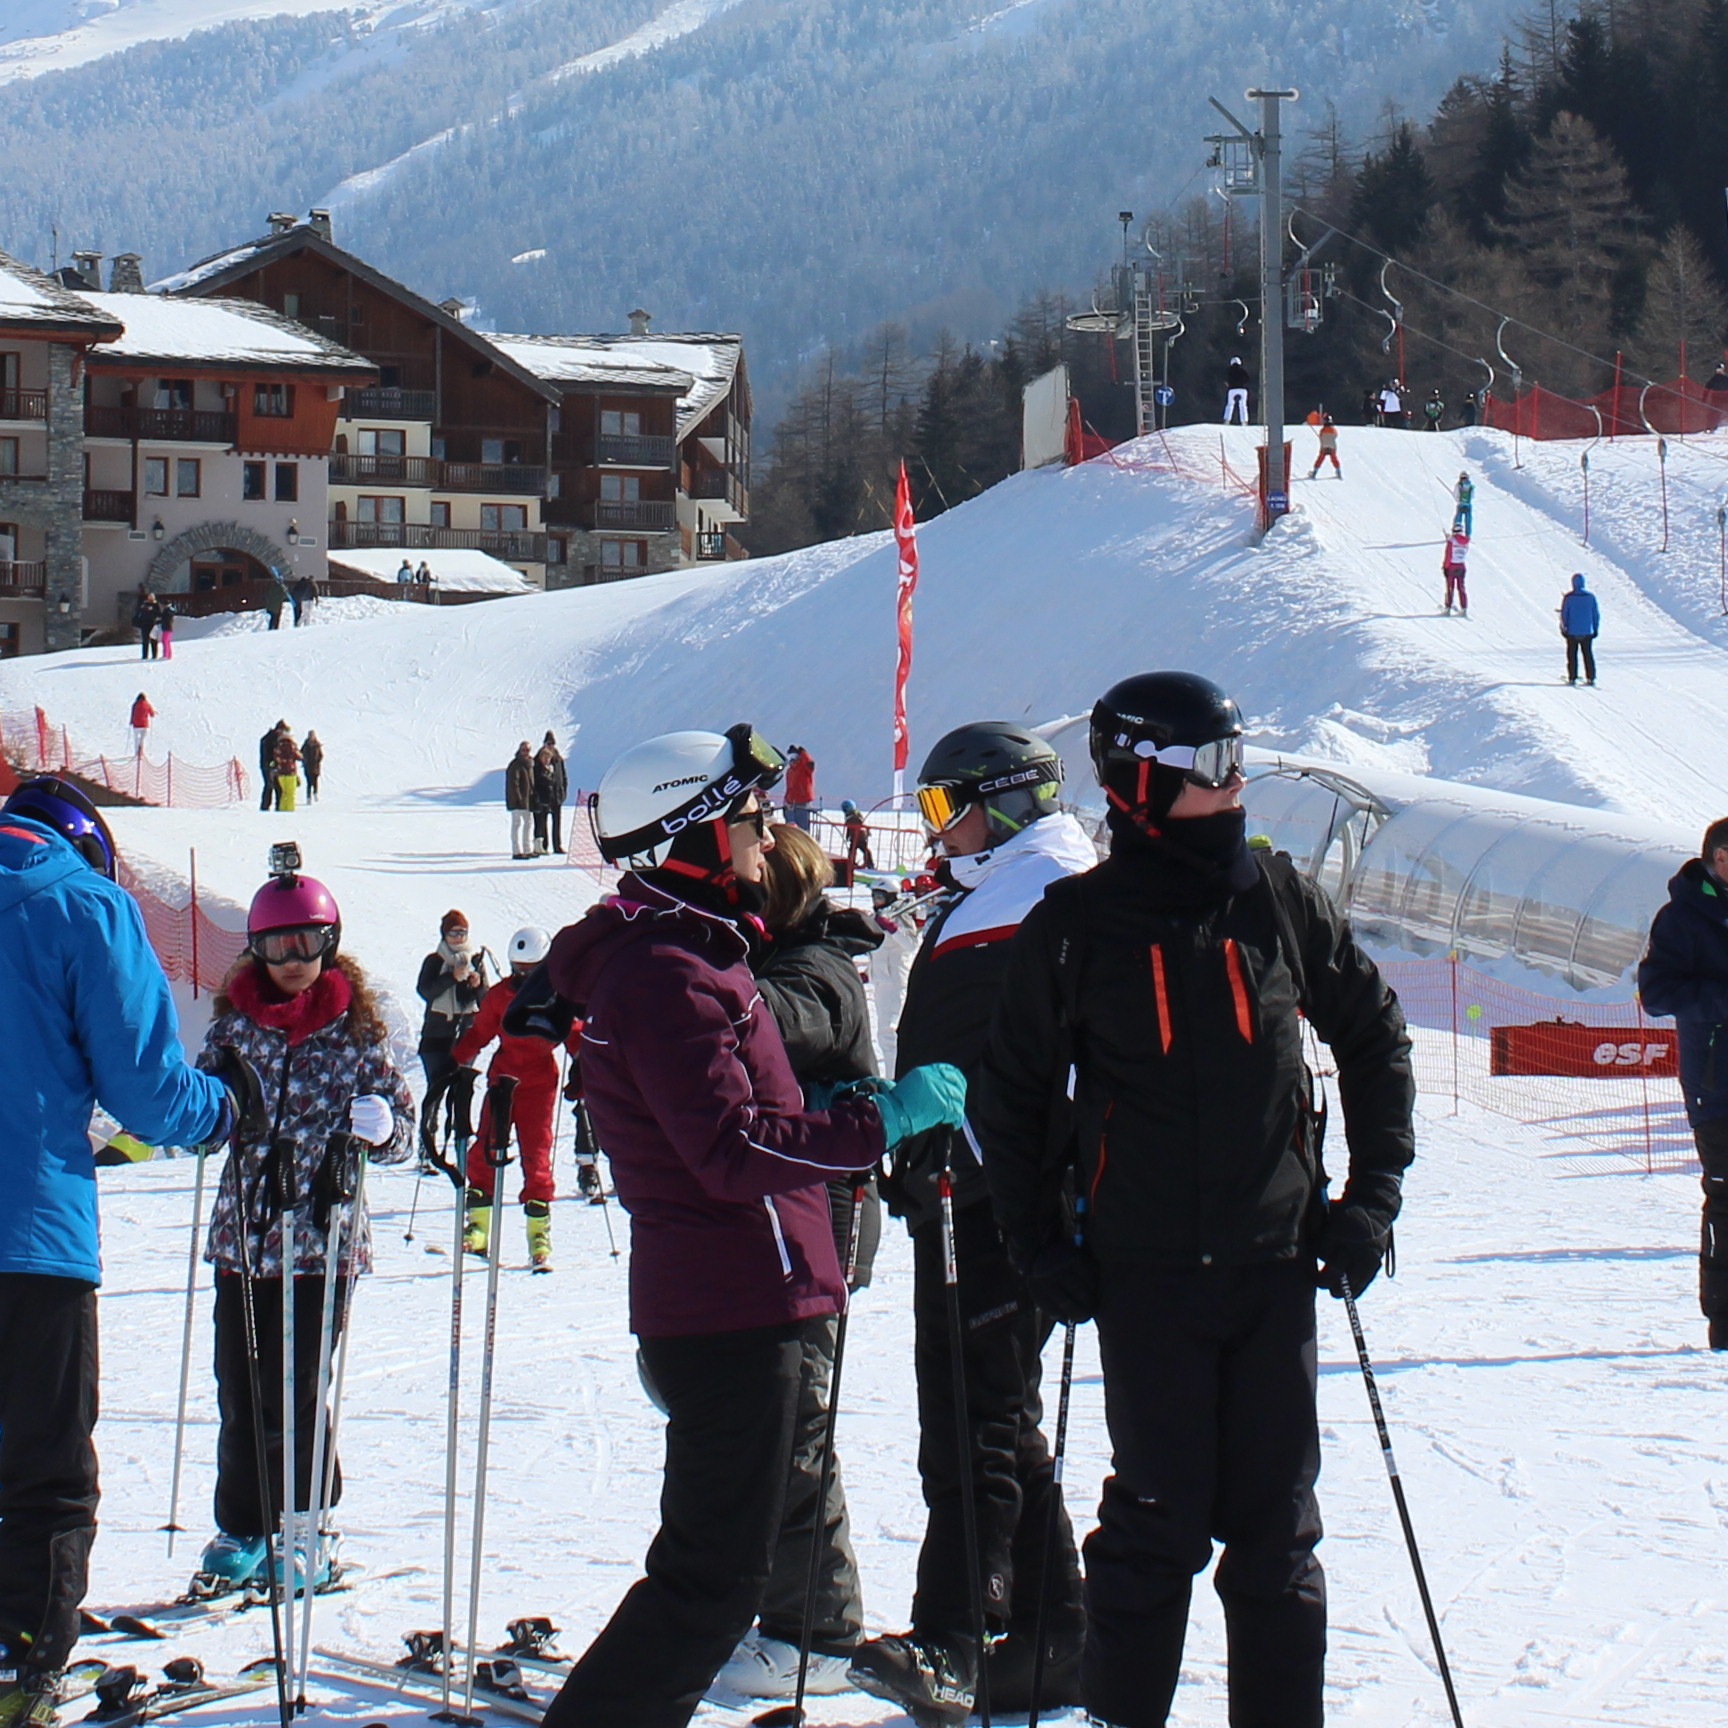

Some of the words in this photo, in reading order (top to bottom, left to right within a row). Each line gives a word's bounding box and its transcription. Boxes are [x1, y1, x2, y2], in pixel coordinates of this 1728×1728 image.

[652, 774, 710, 794] ATOMIC
[660, 775, 743, 835] bollé
[933, 1683, 976, 1710] HEAD
